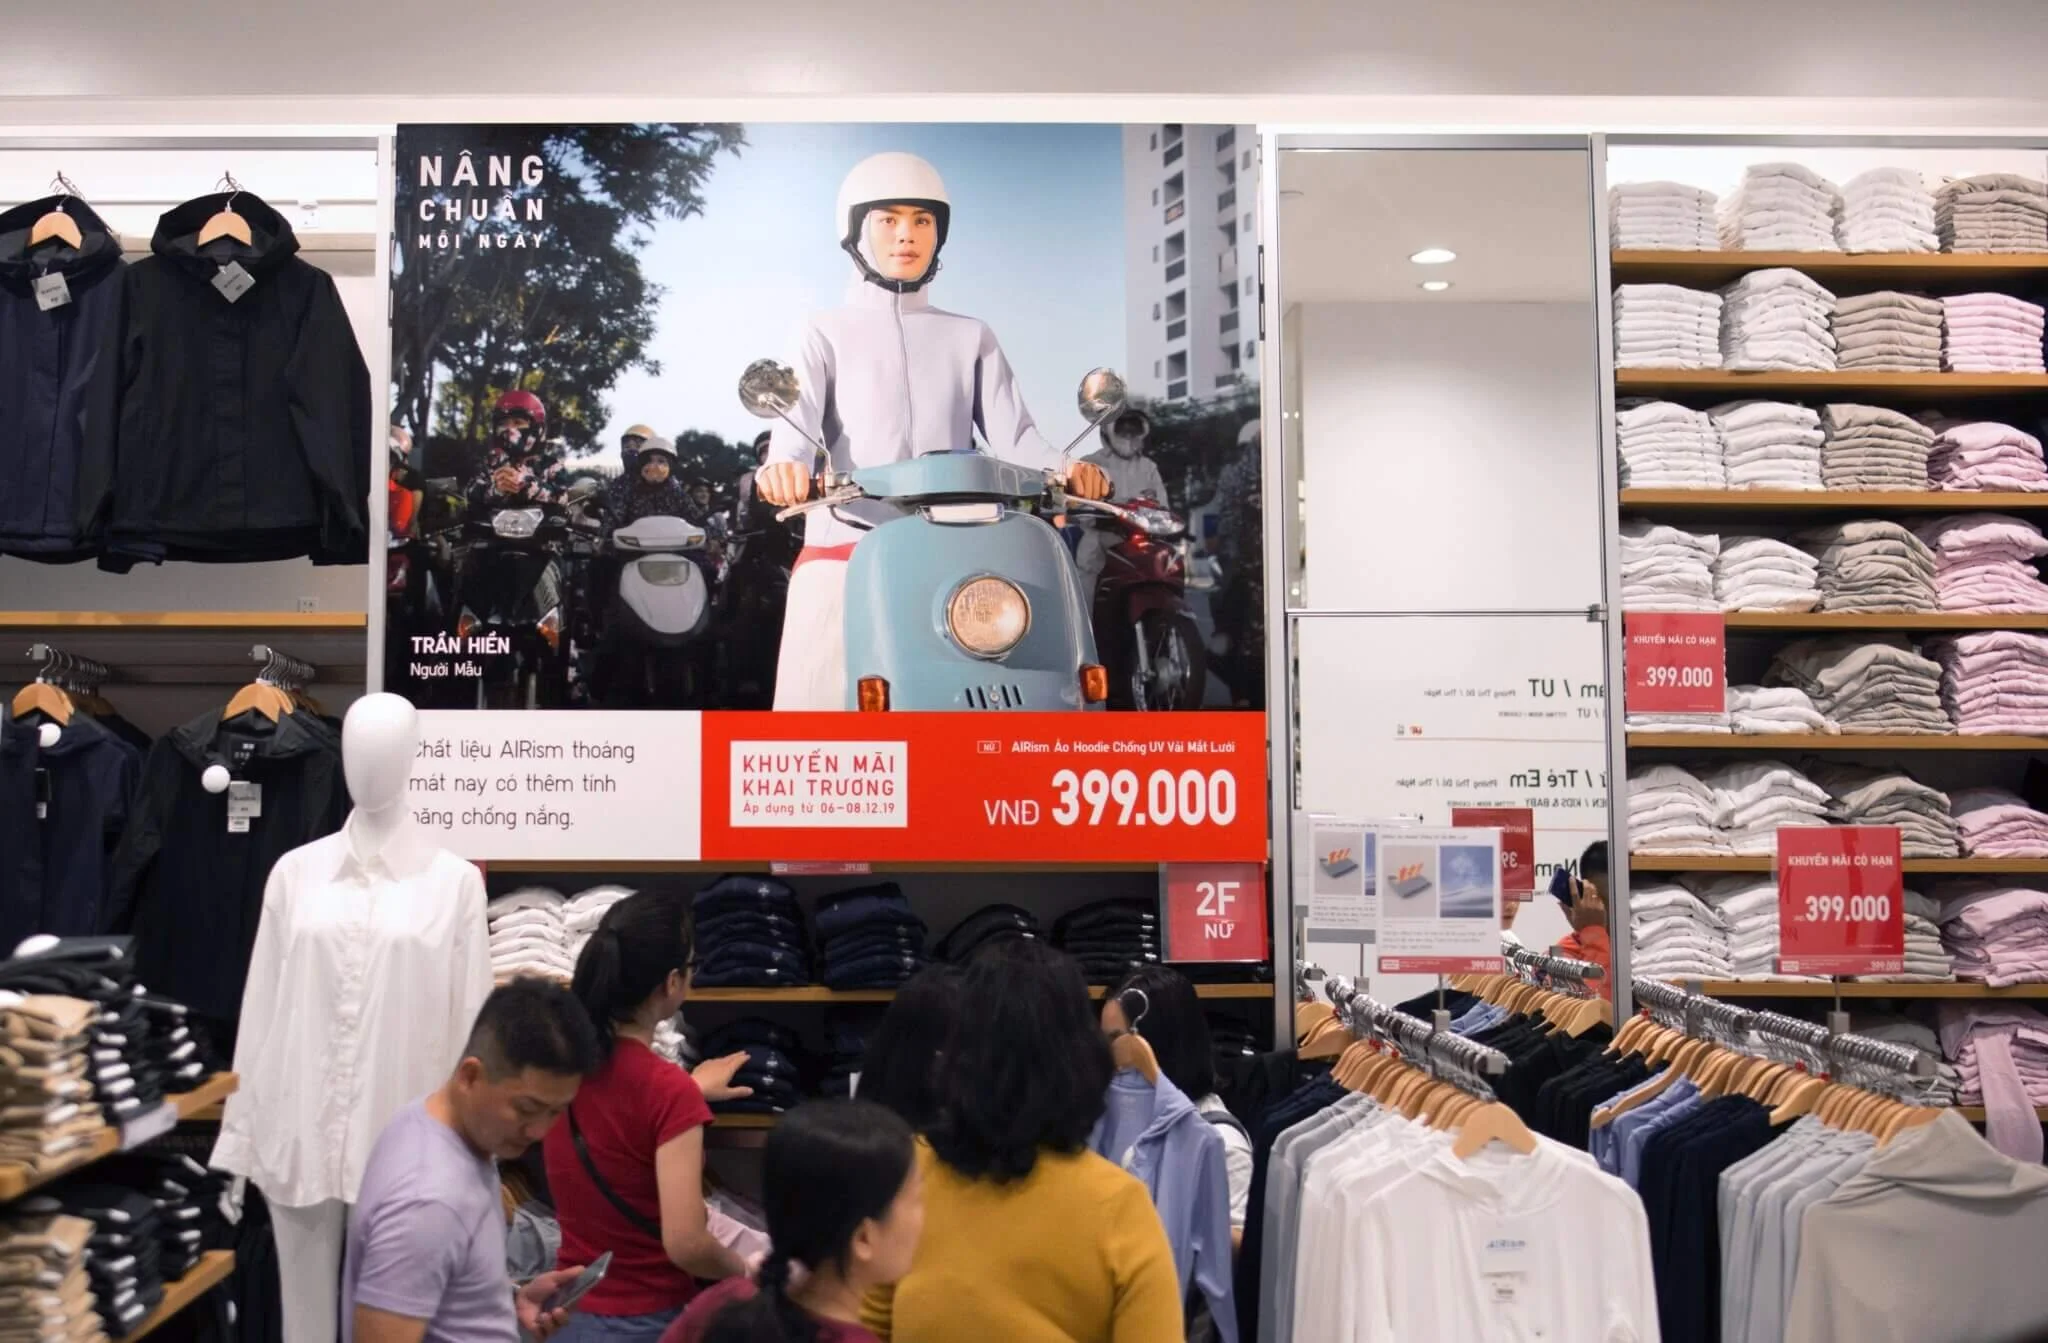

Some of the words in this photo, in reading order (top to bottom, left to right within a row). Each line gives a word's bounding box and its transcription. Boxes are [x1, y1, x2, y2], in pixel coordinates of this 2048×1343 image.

[420, 149, 544, 187] NÂNG
[479, 231, 543, 248] NGÀY
[410, 662, 449, 680] Người
[454, 660, 482, 676] Mẫu
[1646, 666, 1713, 688] 399.000
[460, 739, 491, 762] liệu
[500, 740, 564, 759] AIRism
[573, 739, 634, 763] thoáng
[1012, 741, 1049, 753] AIRism
[1074, 741, 1109, 753] Hoodie
[1149, 741, 1164, 753] UV
[743, 748, 838, 773] KHUYẾN
[408, 773, 445, 791] mát
[454, 778, 487, 796] nay
[496, 774, 517, 791] có
[526, 773, 573, 792] thêm
[583, 773, 616, 792] tính
[743, 779, 793, 796] KHAI
[806, 778, 894, 796] TRƯƠNG
[743, 800, 759, 816] Áp
[765, 802, 794, 816] dụng
[983, 799, 1040, 825] VNĐ
[1051, 769, 1237, 826] 399.000
[461, 804, 517, 830] chống
[525, 803, 574, 830] nắng.
[1870, 855, 1893, 868] HẠN
[1196, 881, 1240, 916] 2F
[1804, 895, 1890, 921] 399.000
[1204, 919, 1235, 939] NỮ
